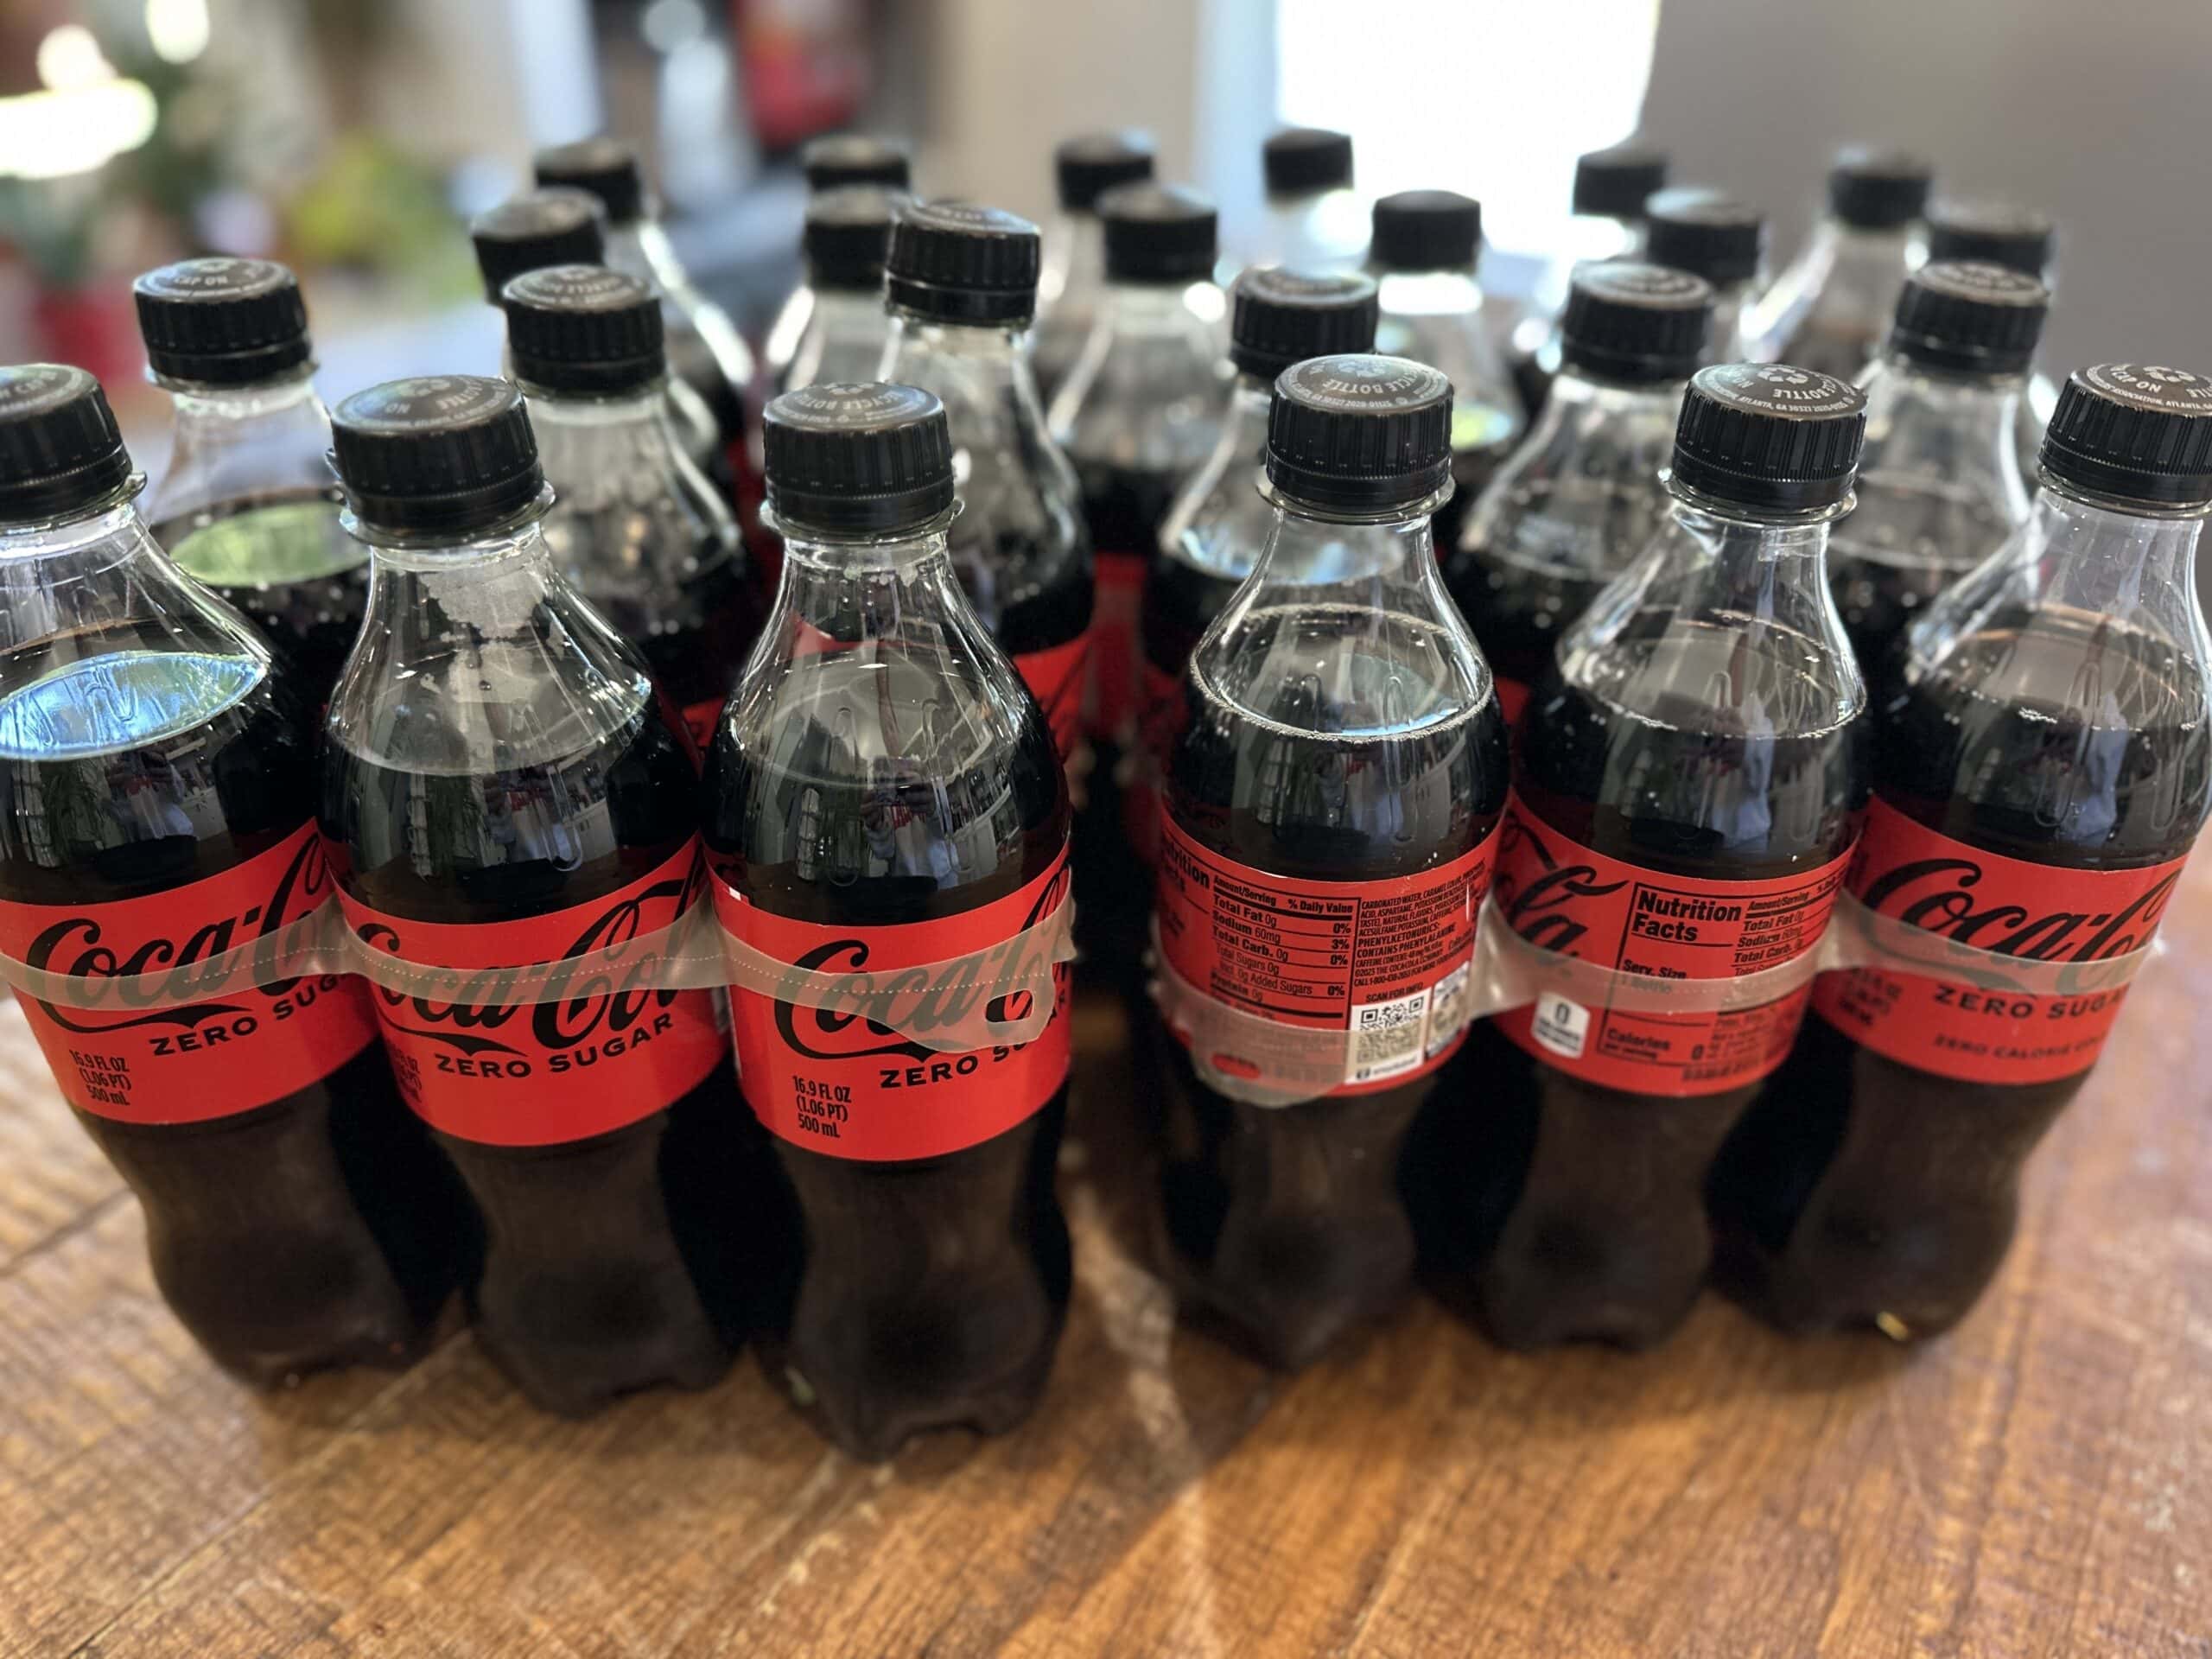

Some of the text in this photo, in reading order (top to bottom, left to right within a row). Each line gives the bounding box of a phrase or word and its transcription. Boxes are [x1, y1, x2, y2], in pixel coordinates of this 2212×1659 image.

[1322, 378, 1383, 395] BOTTLE
[1772, 388, 1830, 400] BOTTLE
[2135, 380, 2162, 393] ON
[1214, 874, 1277, 907] Amount/Serving
[1300, 899, 1325, 914] Daily
[1326, 903, 1353, 913] Value
[1637, 890, 1742, 922] Nutrition
[1214, 894, 1351, 935] Total Fat 0g 0%
[1631, 912, 1699, 942] Facts
[1743, 918, 1774, 932] Total
[1776, 914, 1795, 927] Fat
[27, 832, 338, 1033] Coca-Co
[1212, 910, 1252, 936] Sodium
[1332, 938, 1350, 950] 3%
[1357, 945, 1398, 959] CONTAINS
[1399, 922, 1457, 952] PHENYLALANINE
[1737, 934, 1781, 948] Sodium
[1857, 857, 2183, 1001] Coca-Co
[1212, 925, 1348, 966] Total Carb. 0g 0%
[1734, 950, 1764, 963] Total
[1236, 950, 1266, 971] Sugars
[1267, 962, 1280, 976] 0g
[1623, 959, 1656, 976] Serv.
[1249, 974, 1278, 989] Added
[1280, 980, 1313, 995] Sugars
[1327, 985, 1344, 996] 0%
[1366, 992, 1388, 1004] SCAN
[148, 975, 338, 1057] ZERO SUG
[1933, 984, 2033, 1020] ZERO
[2046, 988, 2125, 1020] SUG
[434, 1052, 532, 1079] ZERO
[548, 1013, 675, 1073] SUGAR
[93, 1055, 111, 1071] FL
[110, 1056, 130, 1073] OZ
[880, 1055, 978, 1090] ZERO
[108, 1073, 132, 1091] PT)
[792, 1075, 852, 1103] 16.9 FL OZ
[109, 1090, 130, 1106] mL
[796, 1094, 849, 1123] (1.06 PT)
[798, 1112, 841, 1139] 500 mL
